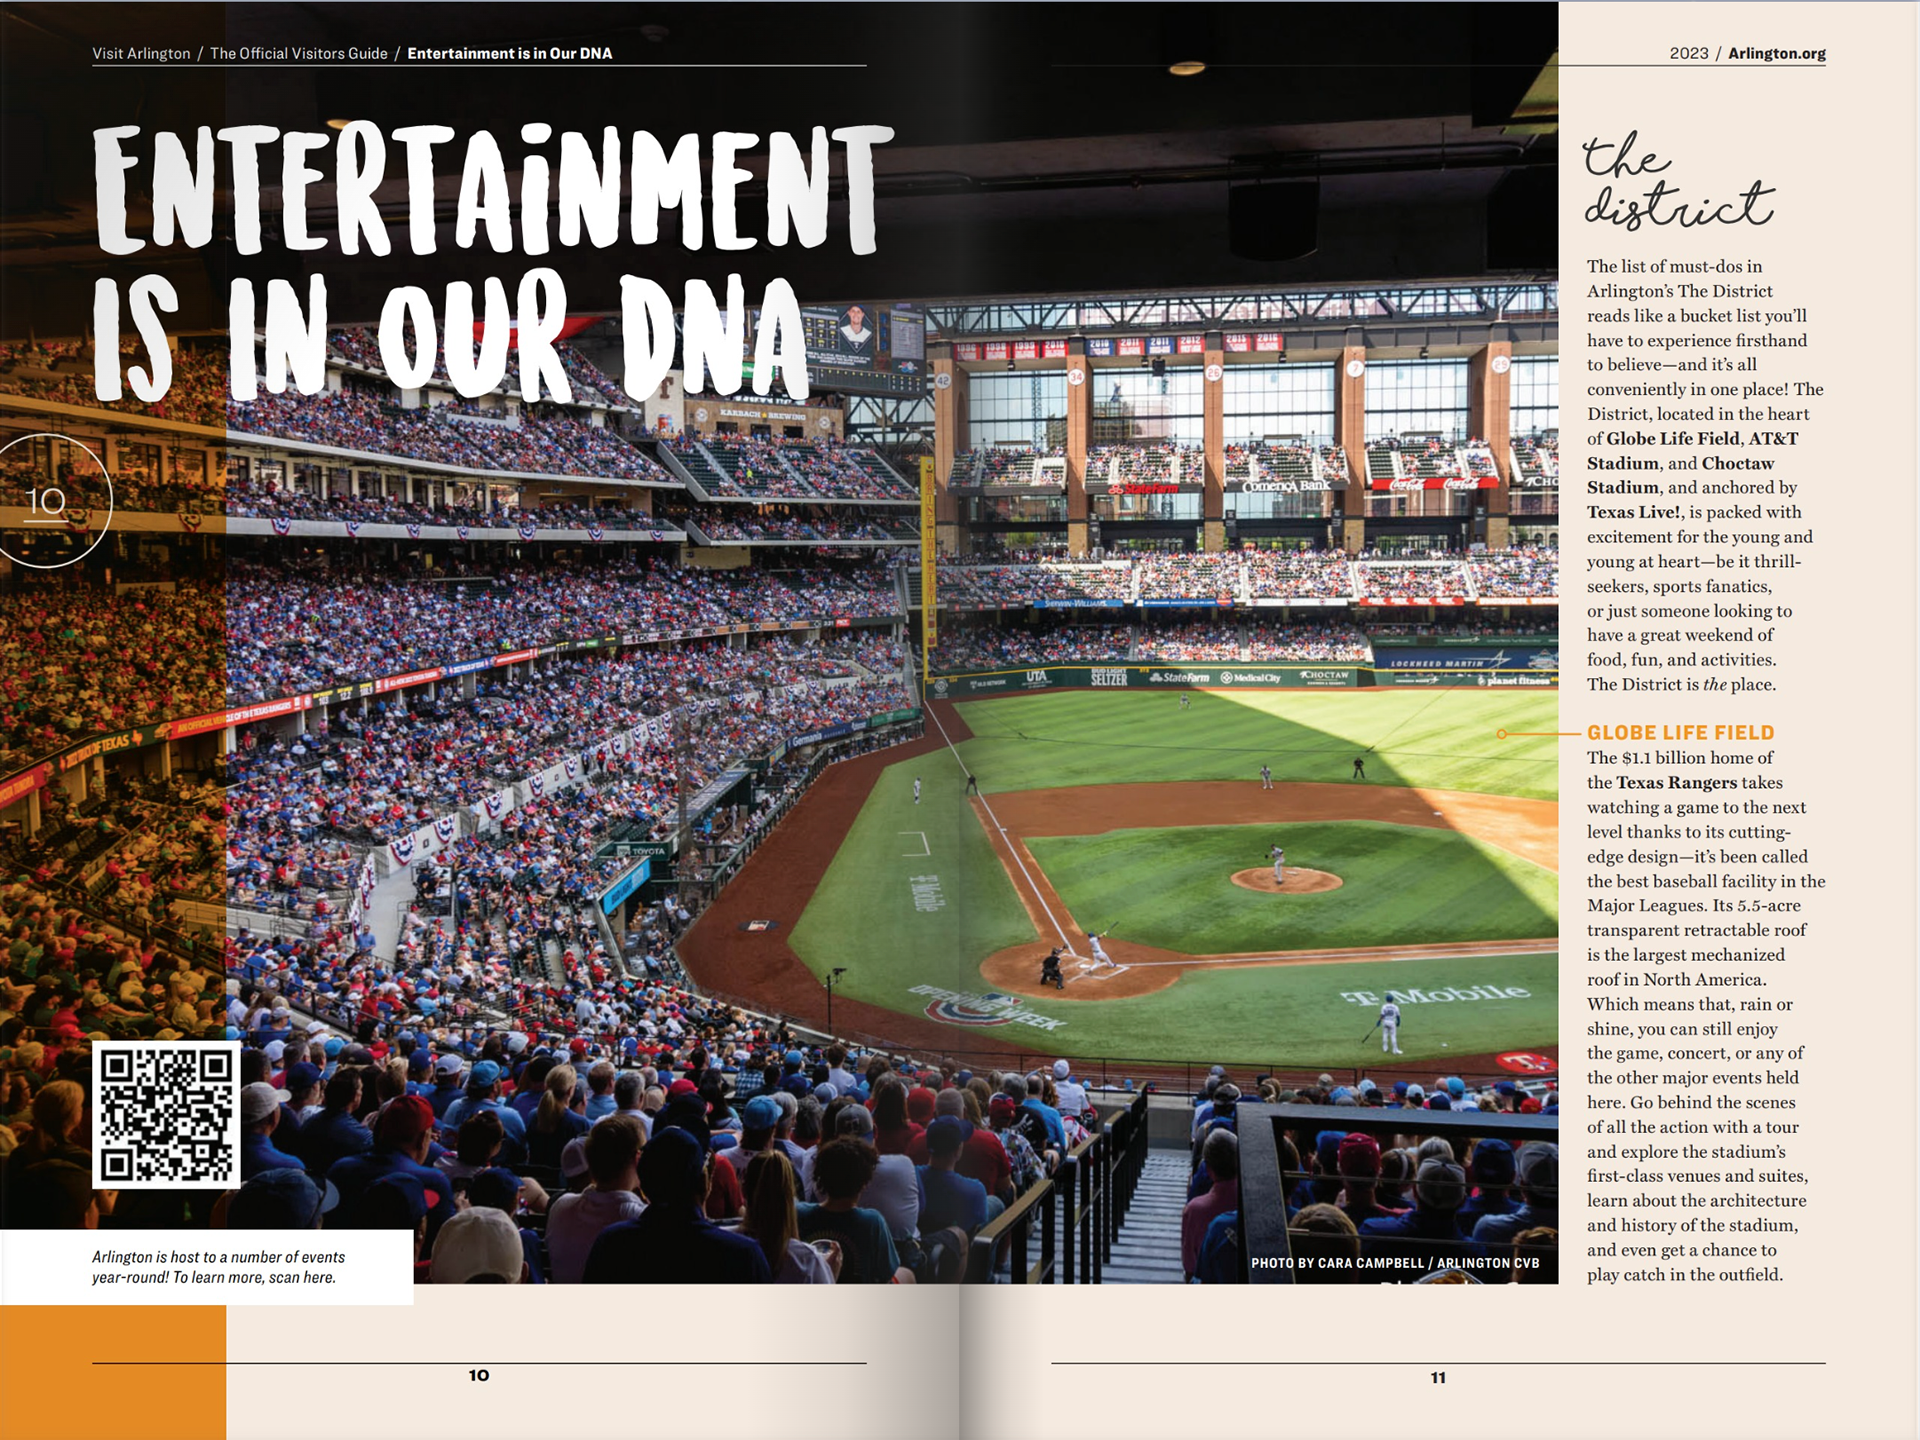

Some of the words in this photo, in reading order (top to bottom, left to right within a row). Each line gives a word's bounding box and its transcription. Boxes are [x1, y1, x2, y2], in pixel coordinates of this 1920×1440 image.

[93, 48, 123, 59] Visit
[128, 47, 190, 62] Arlington
[210, 47, 236, 59] The
[240, 47, 287, 59] Official
[292, 48, 344, 59] Visitors
[349, 47, 387, 59] Guide
[408, 47, 515, 59] Entertainment
[519, 47, 530, 59] is
[534, 47, 546, 59] in
[550, 47, 577, 59] Our
[581, 47, 612, 59] DNA
[1670, 47, 1709, 59] 2023
[1728, 47, 1826, 62] Arlington.org
[1582, 130, 1672, 178] the
[1585, 180, 1776, 232] district
[1587, 259, 1617, 273] The
[1621, 259, 1646, 273] list
[1650, 259, 1667, 273] of
[1670, 259, 1742, 273] must-dos
[1747, 259, 1762, 273] in
[1587, 284, 1673, 301] Arlington’s
[1677, 284, 1708, 298] The
[1713, 284, 1773, 298] District
[94, 275, 178, 401] IS
[230, 274, 327, 401] IN
[378, 268, 571, 403] OUR
[620, 274, 809, 401] DNA
[1120, 338, 1139, 346] 2011
[1180, 336, 1200, 344] 2012
[720, 409, 760, 418] KARBACH
[768, 412, 806, 421] BREWING
[1587, 431, 1604, 445] of
[1607, 431, 1656, 445] Globe
[1660, 431, 1693, 445] Life
[1697, 431, 1744, 448] Field,
[1748, 432, 1799, 445] AT&T
[1587, 456, 1663, 472] Stadium,
[1668, 456, 1697, 470] and
[1702, 456, 1775, 470] Choctaw
[1300, 480, 1331, 491] Bank
[26, 489, 64, 514] 10
[1587, 506, 1635, 519] Texas
[1639, 505, 1685, 521] Live!,
[1690, 505, 1702, 518] is
[1707, 505, 1762, 522] packed
[1766, 505, 1802, 518] with
[1026, 670, 1047, 682] UTA
[1091, 674, 1127, 686] SELTZER
[1234, 674, 1264, 682] Medical
[1265, 674, 1281, 683] City
[1304, 671, 1349, 679] CHOCTAW
[1488, 677, 1517, 686] planet
[1519, 677, 1550, 685] fitness
[178, 724, 187, 733] AN
[188, 718, 213, 730] OFFICIAL
[1588, 725, 1656, 740] GLOBE
[1663, 725, 1707, 740] LIFE
[1715, 725, 1774, 740] FIELD
[92, 741, 101, 754] OF
[101, 734, 129, 751] TEXAS
[793, 731, 822, 746] Germania
[1587, 750, 1617, 764] The
[1623, 751, 1651, 766] $1.1
[1655, 750, 1706, 764] billion
[1711, 750, 1753, 764] home
[1758, 750, 1775, 764] of
[1587, 775, 1612, 789] the
[1616, 776, 1664, 789] Texas
[1668, 776, 1737, 793] Rangers
[1742, 775, 1783, 789] takes
[908, 984, 1004, 1012] OPENING
[996, 1007, 1068, 1031] WEEK
[92, 1250, 152, 1266] Arlington
[156, 1251, 167, 1263] is
[171, 1250, 200, 1263] host
[204, 1252, 216, 1263] to
[220, 1254, 227, 1263] a
[231, 1250, 282, 1263] number
[285, 1250, 300, 1263] of
[302, 1252, 345, 1263] events
[1252, 1258, 1293, 1268] PHOTO
[1299, 1258, 1314, 1268] BY
[1319, 1258, 1352, 1268] CARA
[1357, 1258, 1424, 1268] CAMPBELL
[1438, 1258, 1509, 1269] ARLINGTON
[1514, 1258, 1539, 1268] CVB
[92, 1270, 169, 1286] year-round!
[174, 1271, 188, 1283] To
[192, 1270, 225, 1283] learn
[228, 1274, 265, 1285] more,
[269, 1274, 300, 1283] scan
[303, 1270, 335, 1283] here.
[1587, 1267, 1620, 1285] play
[1624, 1267, 1665, 1281] catch
[1670, 1268, 1685, 1281] in
[1690, 1267, 1715, 1281] the
[1719, 1267, 1783, 1281] outfield.
[469, 1369, 489, 1381] 10
[1431, 1372, 1445, 1383] 11
